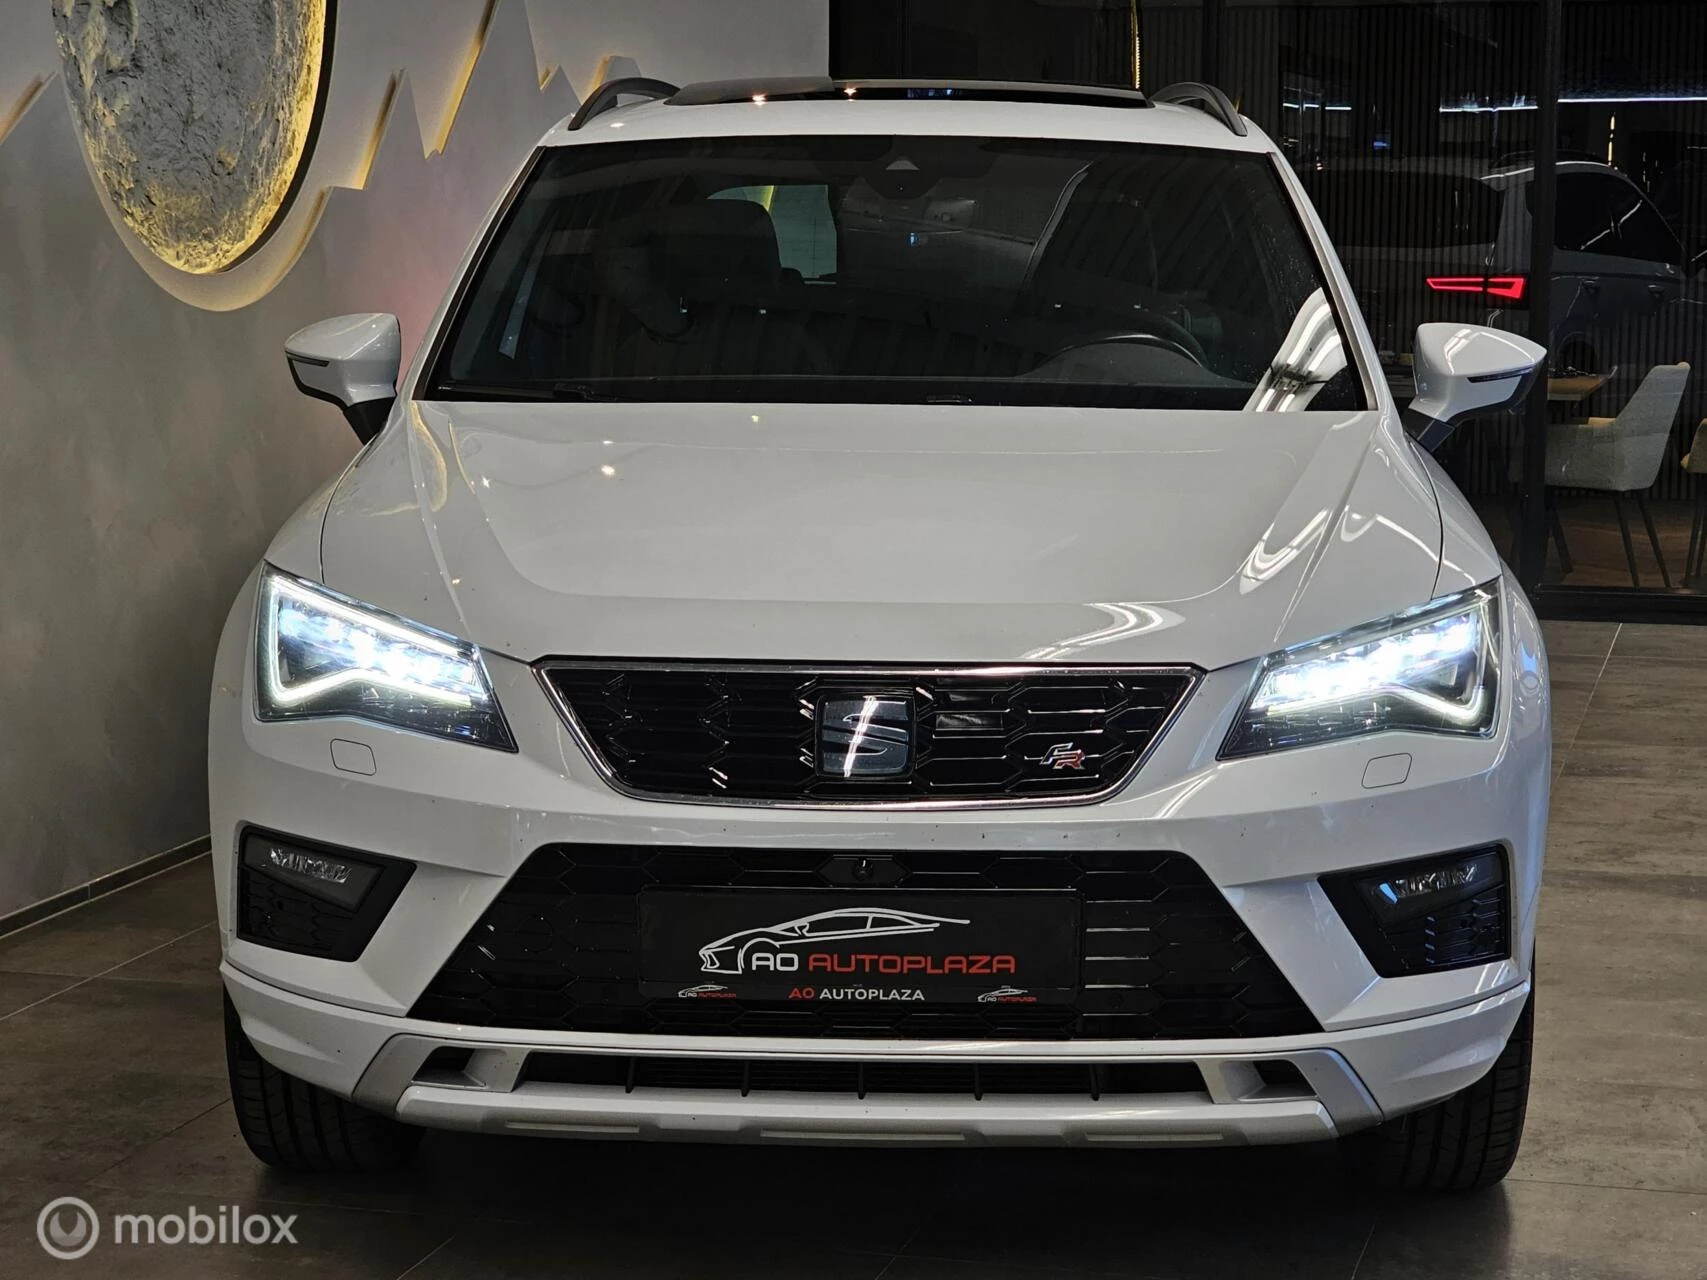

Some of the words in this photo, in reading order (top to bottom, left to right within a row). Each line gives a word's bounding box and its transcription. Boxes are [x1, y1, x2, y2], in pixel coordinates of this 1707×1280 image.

[1040, 742, 1085, 770] FR
[752, 952, 799, 972] AO
[808, 953, 1016, 974] AUTOPLAZA
[789, 987, 815, 999] AO
[820, 988, 925, 1000] AUTOPLAZA
